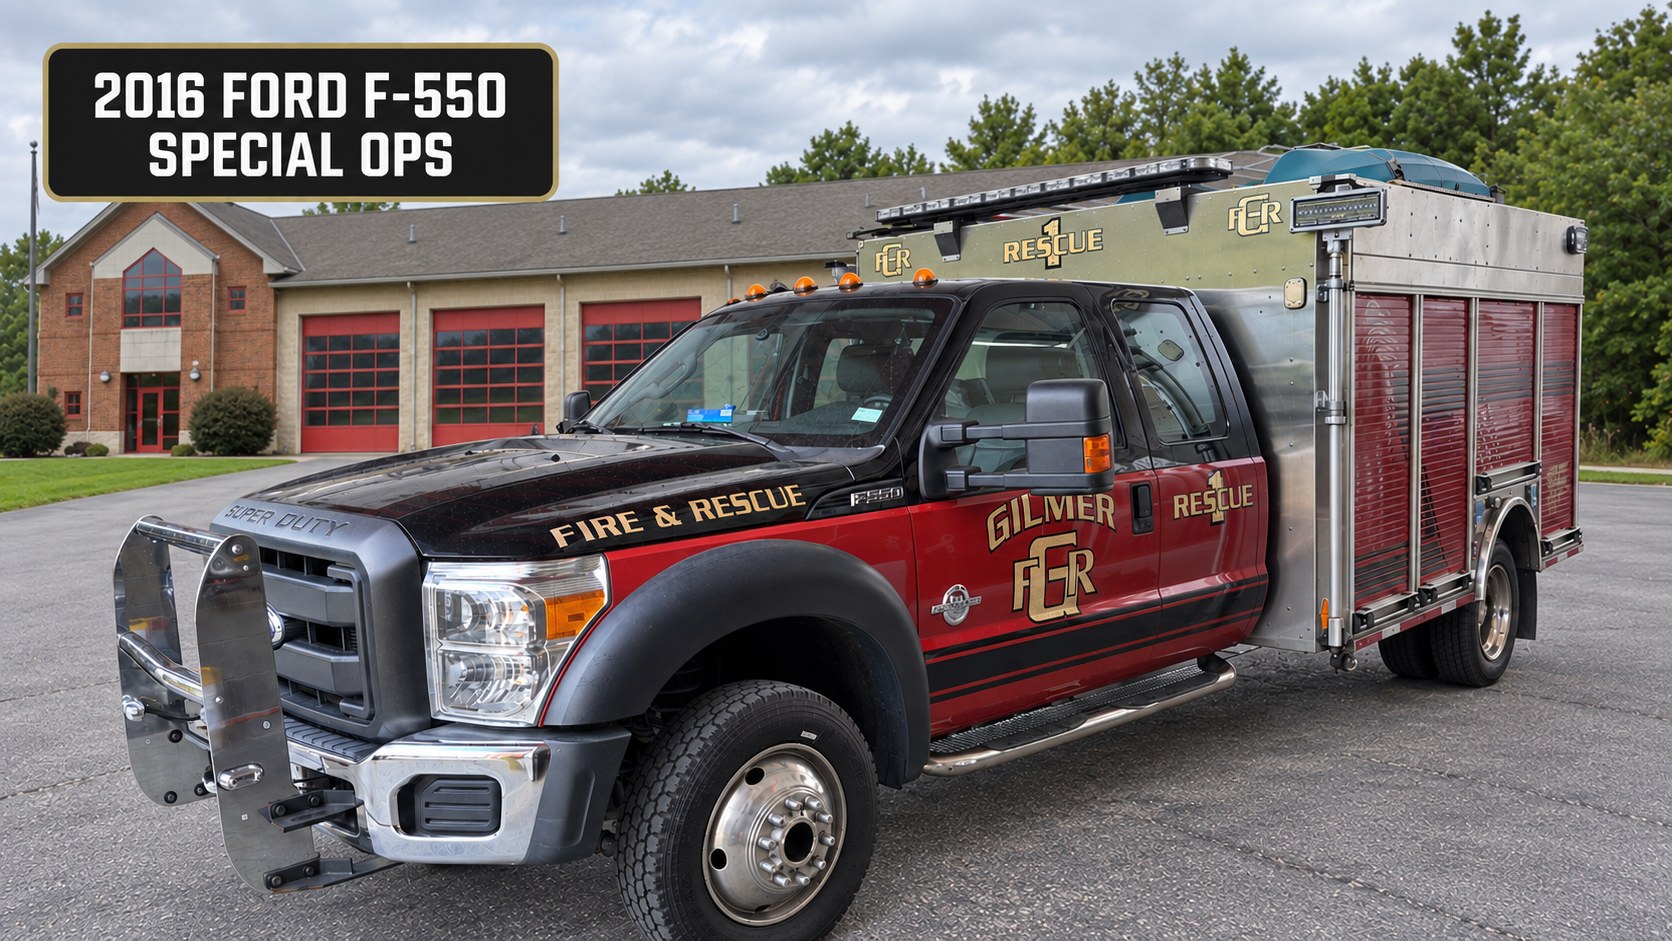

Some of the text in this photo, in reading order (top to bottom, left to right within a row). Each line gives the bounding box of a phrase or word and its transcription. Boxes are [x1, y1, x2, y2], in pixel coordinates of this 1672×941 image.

[1003, 228, 1103, 264] RESCUE
[549, 484, 807, 549] FIRE & RESCUE
[1173, 484, 1254, 520] RESCUE
[224, 504, 349, 537] SUPER DUTY
[987, 492, 1117, 553] GILMER
